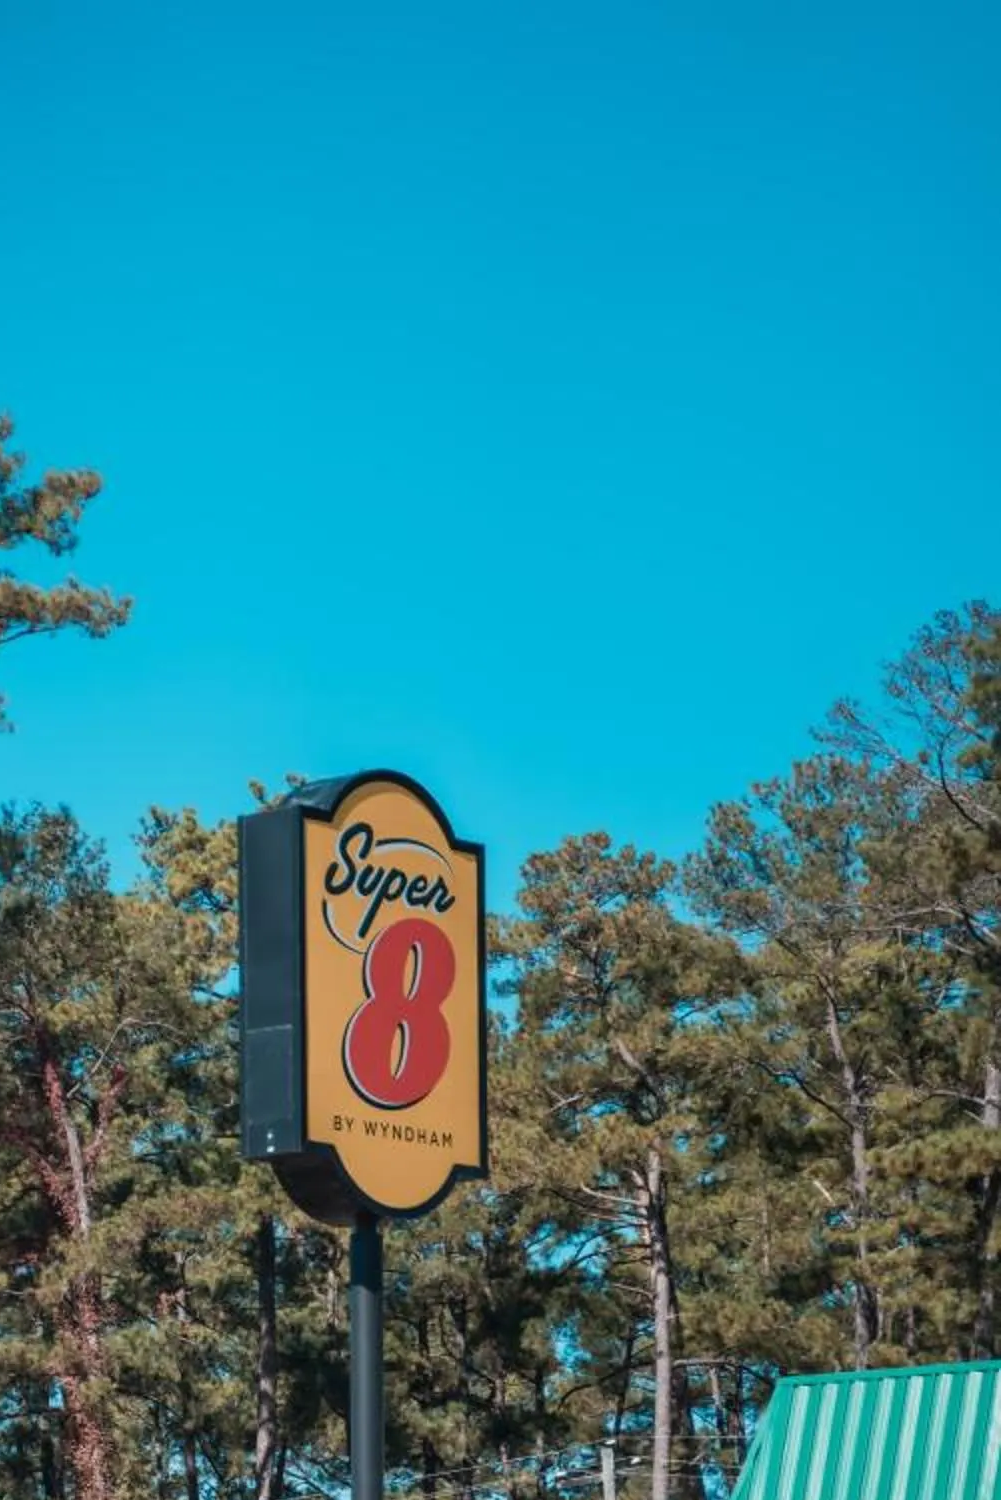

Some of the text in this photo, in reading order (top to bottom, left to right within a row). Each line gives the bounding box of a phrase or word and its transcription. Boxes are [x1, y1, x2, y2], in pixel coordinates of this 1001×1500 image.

[324, 821, 456, 939] Super
[341, 918, 457, 1110] 8
[333, 1115, 453, 1148] BY WYNDHAM
